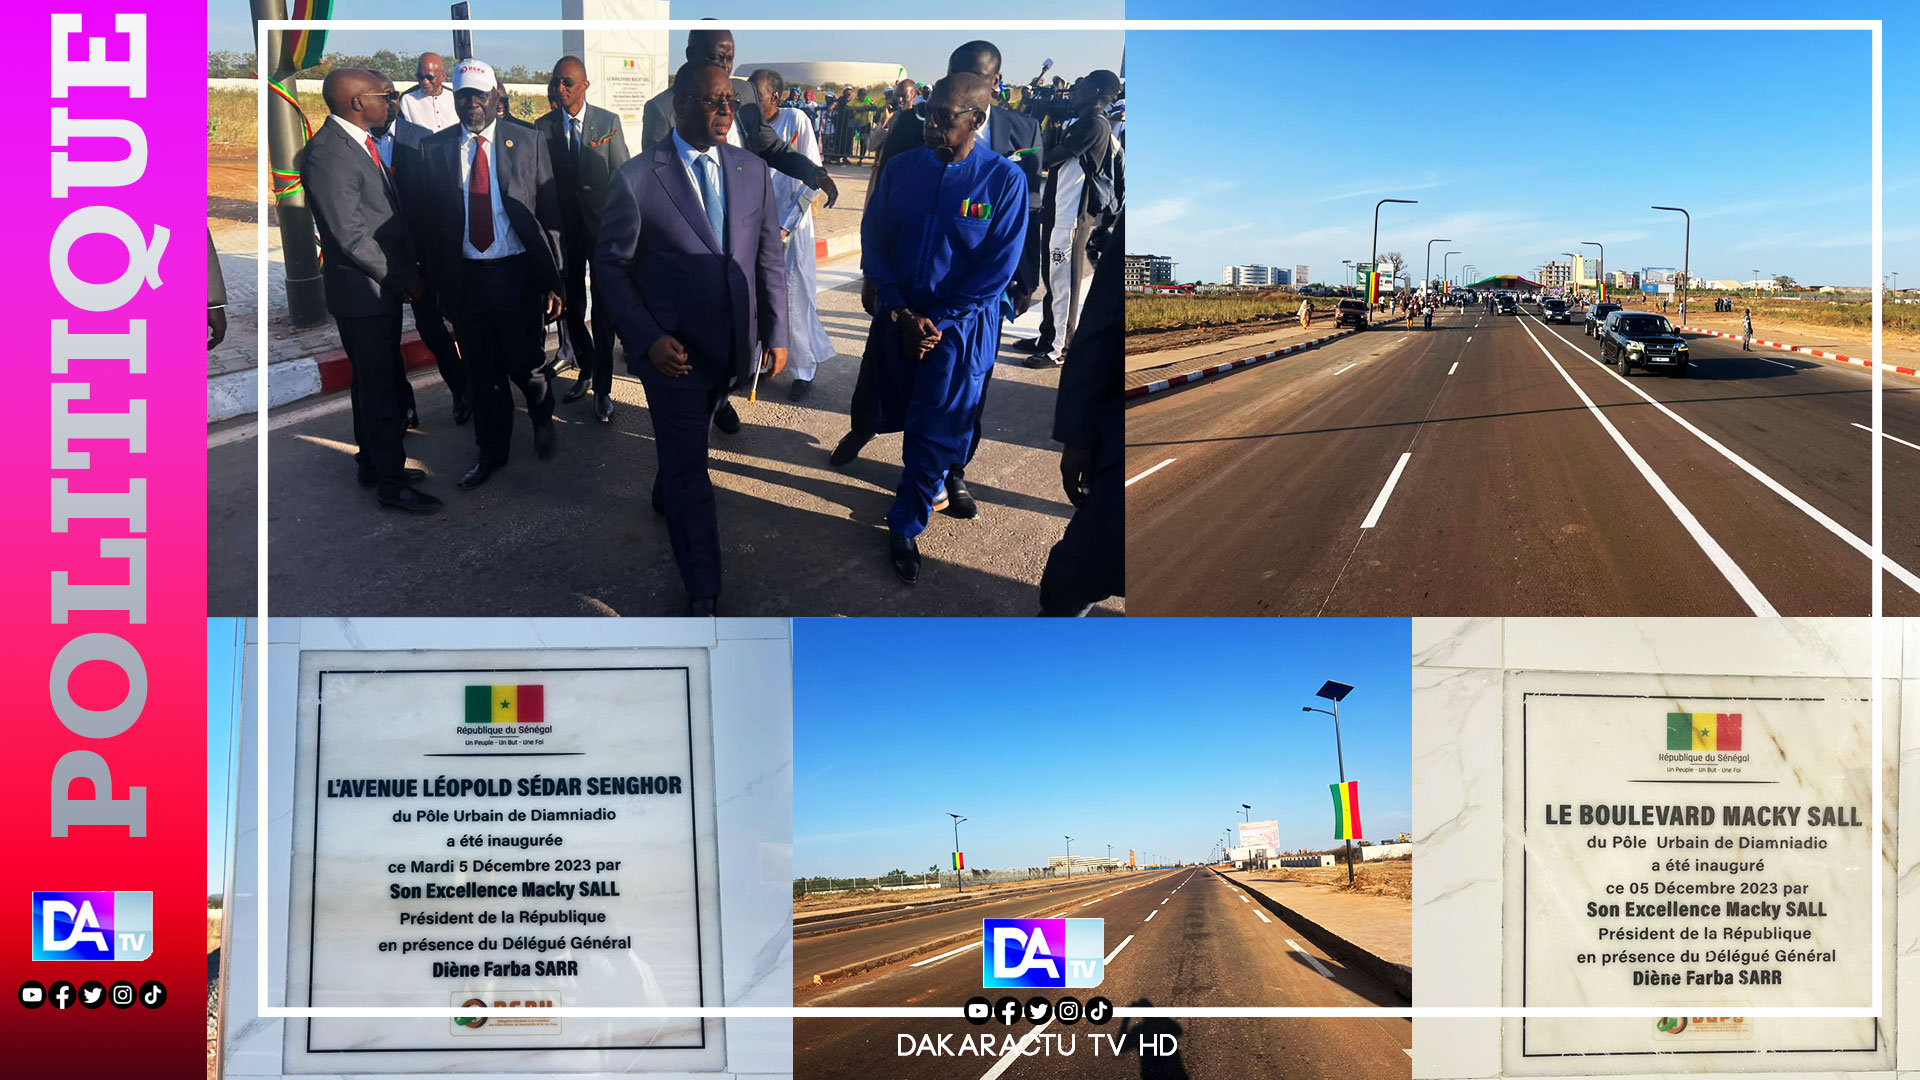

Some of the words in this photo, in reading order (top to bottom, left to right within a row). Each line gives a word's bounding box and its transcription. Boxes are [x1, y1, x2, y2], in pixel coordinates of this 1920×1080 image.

[456, 724, 504, 736] République
[504, 725, 517, 735] du
[518, 724, 553, 736] Sénégal
[1658, 752, 1704, 763] République
[1704, 753, 1716, 763] du
[1717, 753, 1750, 764] Sénégal
[422, 774, 513, 798] LÉOPOLD
[516, 773, 582, 797] SÉDAR
[586, 775, 682, 796] SENGHOR
[392, 809, 412, 823] du
[416, 809, 450, 823] Pôle
[453, 809, 504, 823] Urbain
[507, 808, 527, 822] de
[530, 807, 617, 822] Diamniadio
[1545, 804, 1573, 826] LE
[1579, 804, 1716, 827] BOULEVARD
[1722, 805, 1802, 827] MACKY
[1807, 805, 1863, 827] SALL
[446, 837, 456, 848] a
[459, 833, 484, 848] été
[487, 833, 564, 850] inaugurée
[1586, 835, 1607, 849] du
[1612, 835, 1647, 849] Pôle
[1656, 835, 1709, 849] Urbain
[1714, 835, 1734, 849] de
[1738, 835, 1828, 850] Diamniadio
[387, 863, 407, 874] ce
[410, 859, 455, 874] Mardi
[458, 860, 469, 873] 5
[472, 858, 551, 873] Décembre
[554, 859, 592, 872] 2023
[595, 861, 622, 874] par
[1651, 861, 1660, 872] a
[1665, 858, 1691, 872] été
[1695, 858, 1765, 875] inauguré
[389, 883, 422, 900] Son
[425, 881, 518, 899] Excellence
[521, 880, 576, 901] Macky
[578, 880, 621, 898] SALL
[1605, 884, 1625, 895] ce
[1629, 882, 1649, 895] 05
[1654, 880, 1736, 895] Décembre
[1740, 882, 1778, 895] 2023
[1783, 884, 1809, 898] par
[399, 911, 475, 926] Président
[477, 910, 498, 924] de
[501, 910, 515, 924] la
[519, 909, 607, 927] République
[1586, 901, 1620, 918] Son
[1625, 900, 1721, 918] Excellence
[1726, 900, 1782, 921] Macky
[1785, 901, 1828, 918] SALL
[1598, 926, 1675, 941] Président
[1679, 926, 1700, 940] de
[1704, 926, 1718, 940] la
[1723, 926, 1812, 943] République
[378, 941, 398, 952] en
[402, 937, 475, 955] présence
[477, 936, 498, 951] du
[502, 935, 567, 953] Délégué
[570, 935, 632, 950] Général
[1576, 953, 1596, 964] en
[1601, 949, 1676, 967] présence
[1680, 949, 1700, 963] du
[1705, 948, 1770, 966] Délégué
[1774, 948, 1836, 963] Général
[432, 960, 481, 978] Diène
[483, 960, 531, 977] Farba
[534, 960, 578, 977] SARR
[1633, 969, 1682, 986] Diène
[1686, 969, 1734, 986] Farba
[1738, 969, 1782, 986] SARR
